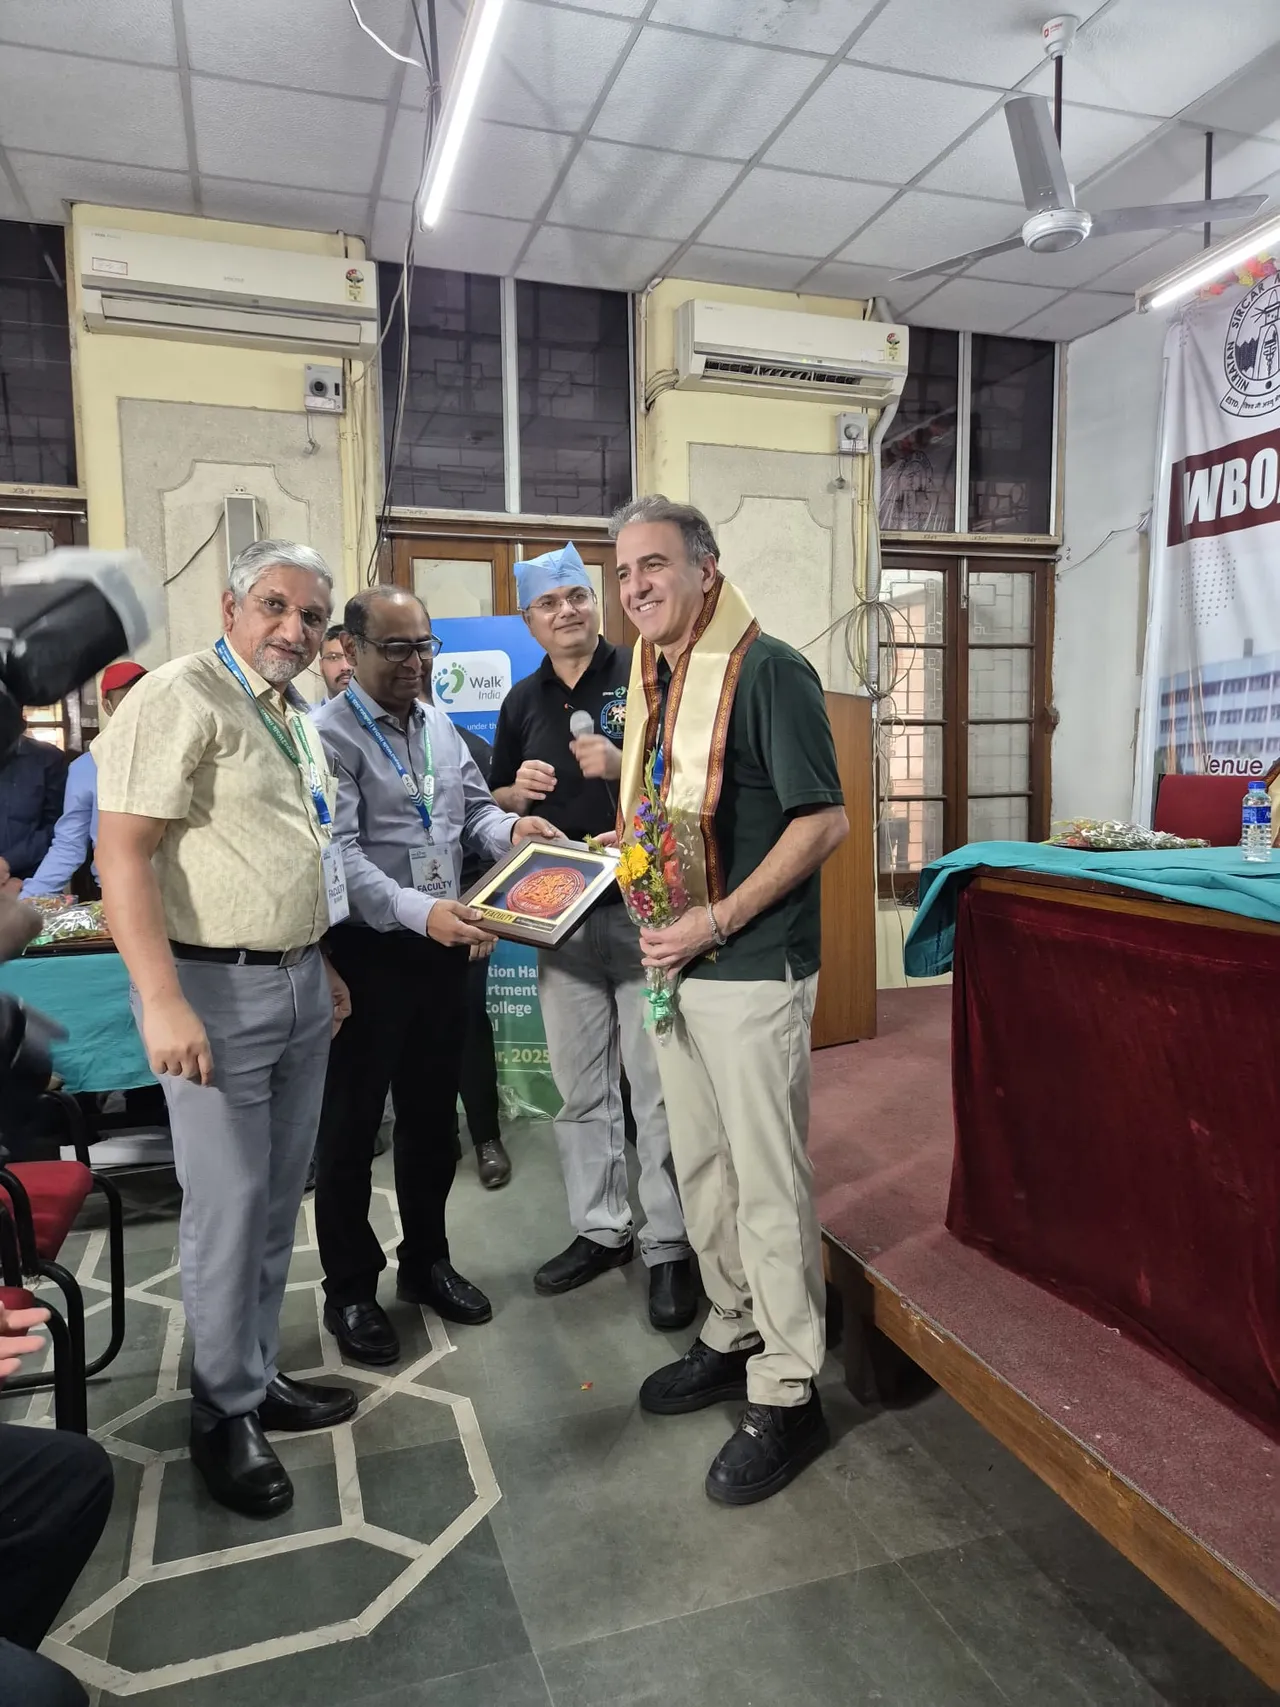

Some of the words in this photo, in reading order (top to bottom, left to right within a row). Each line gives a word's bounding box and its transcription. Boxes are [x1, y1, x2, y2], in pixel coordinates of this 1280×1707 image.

[1231, 283, 1265, 329] SIRCAR
[1226, 341, 1250, 391] NILRATAN
[1183, 447, 1280, 526] WBO
[470, 676, 502, 689] Walk
[478, 690, 501, 700] India
[467, 722, 487, 731] under
[1203, 754, 1263, 775] Venue
[417, 880, 452, 893] FACULTY
[484, 908, 518, 921] FACULTY
[486, 984, 538, 996] rtment
[495, 1051, 509, 1065] r,
[511, 1048, 550, 1063] 2025
